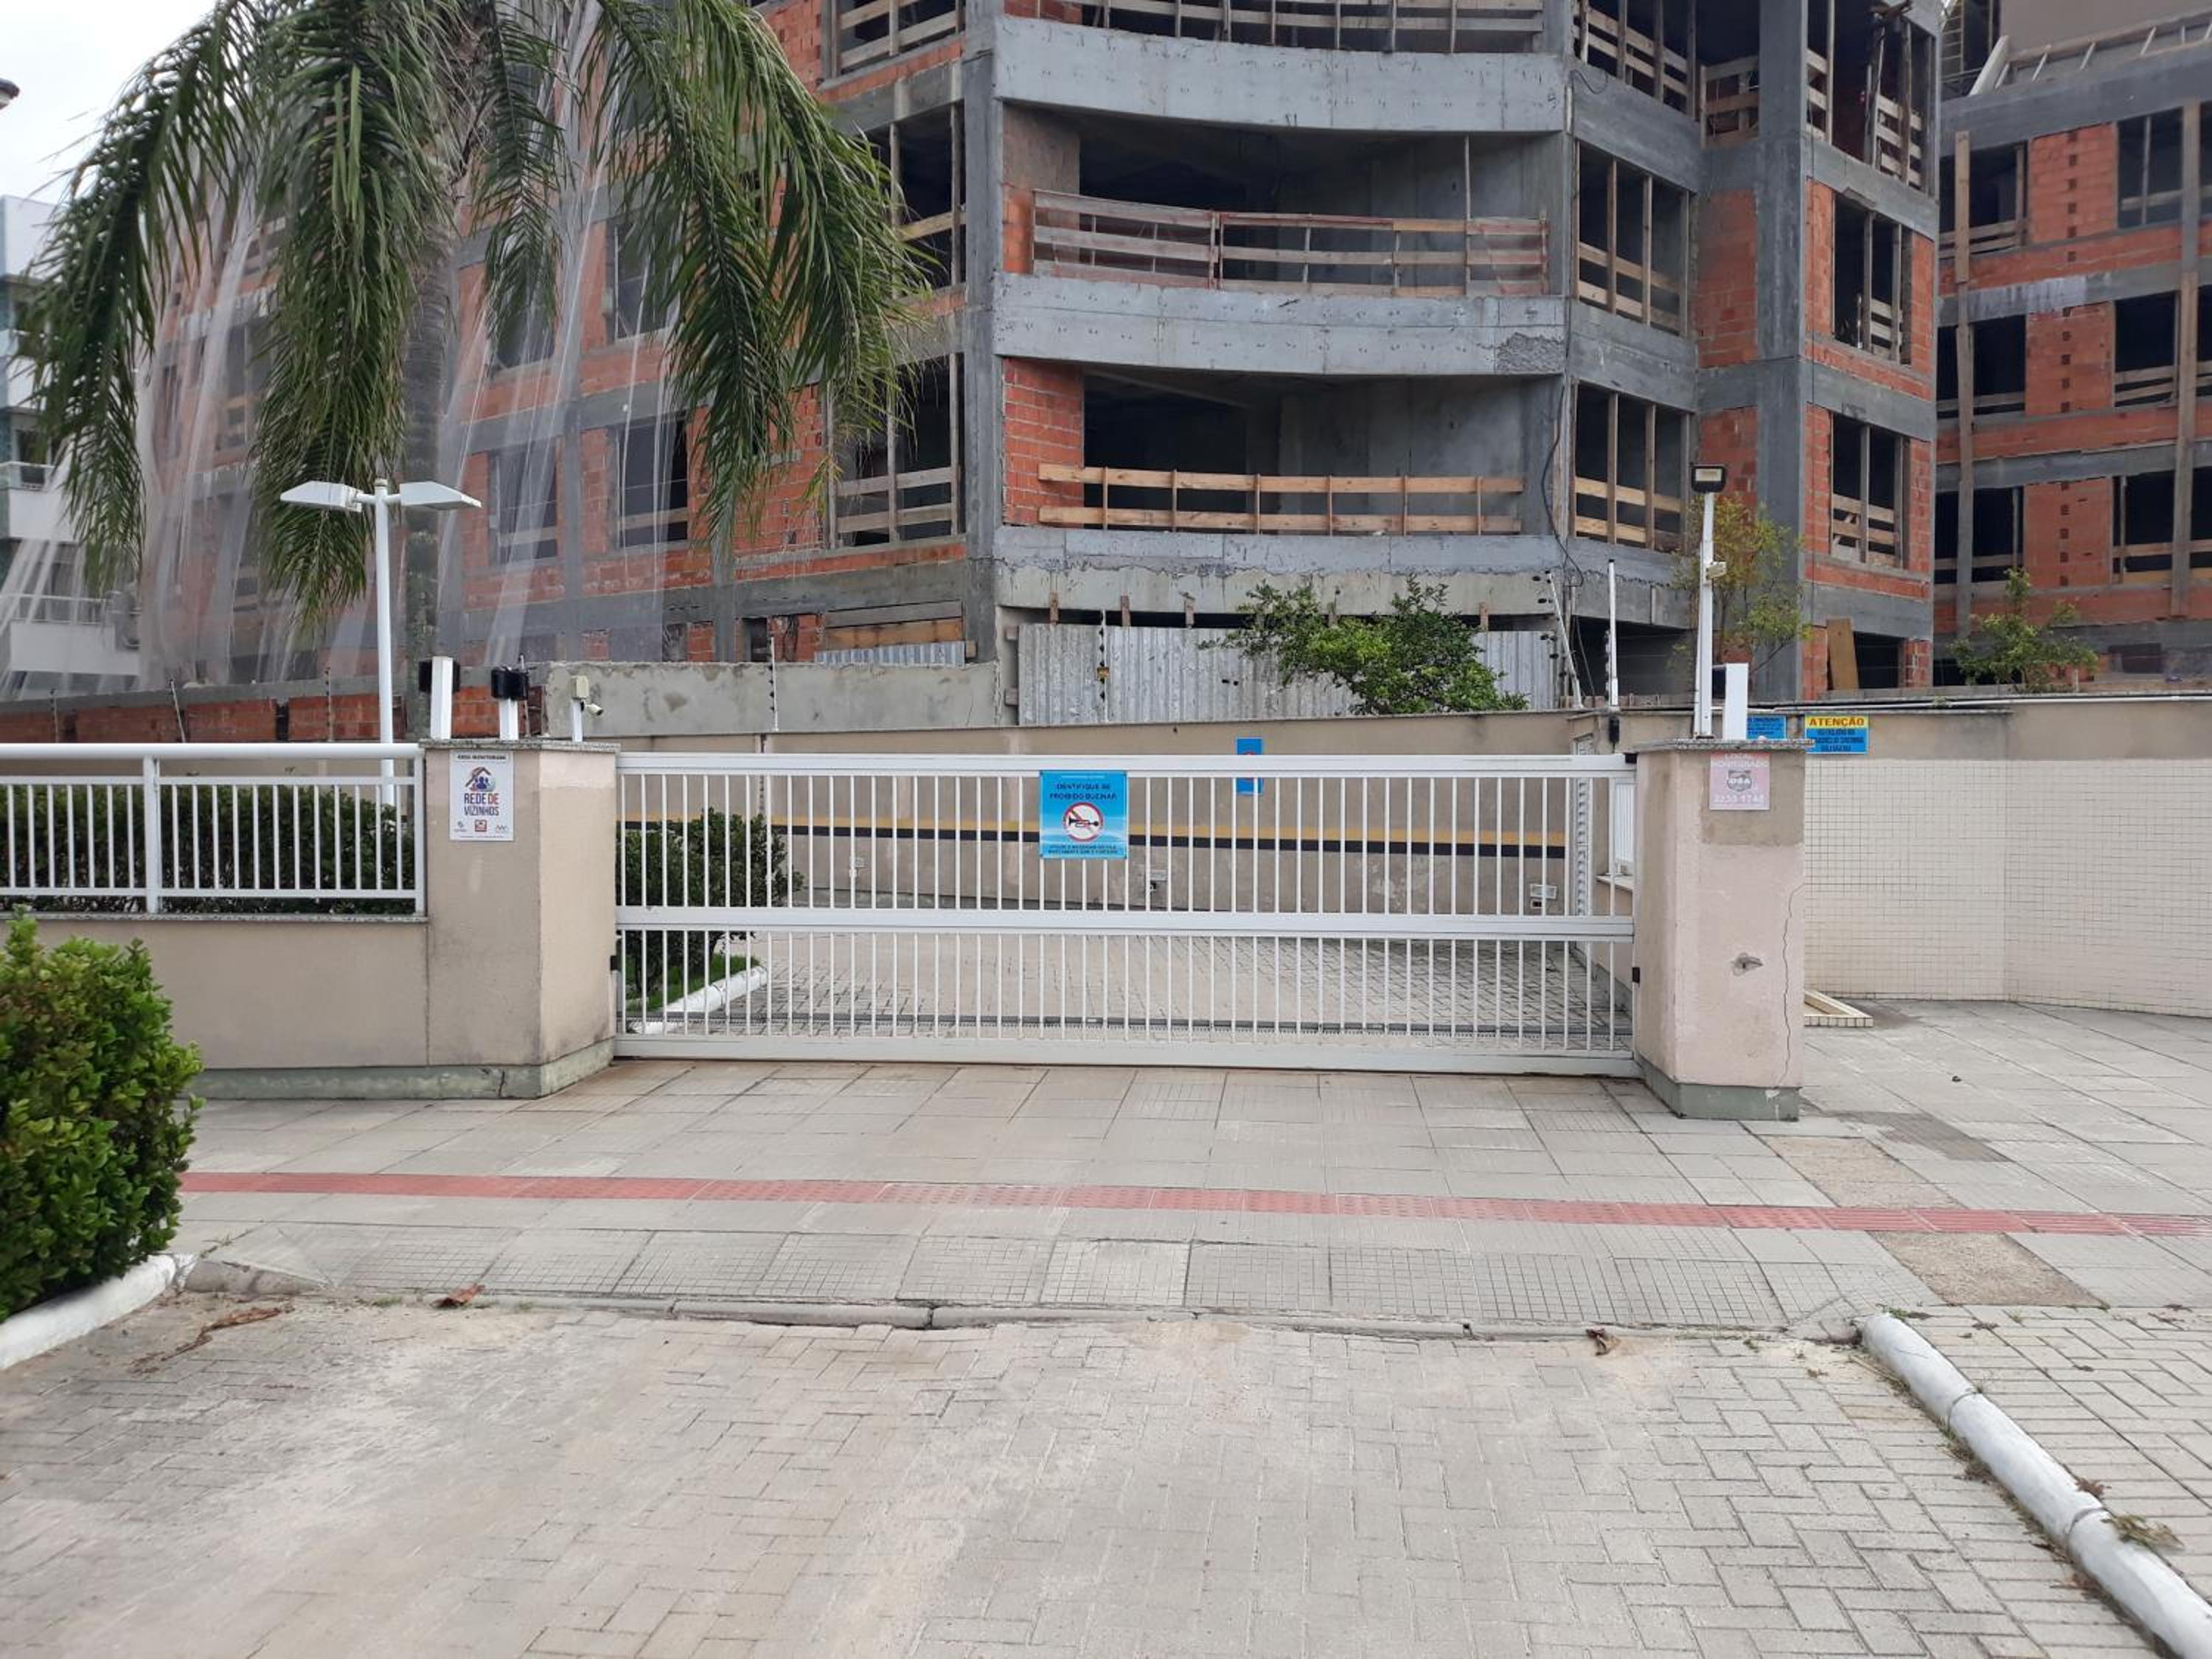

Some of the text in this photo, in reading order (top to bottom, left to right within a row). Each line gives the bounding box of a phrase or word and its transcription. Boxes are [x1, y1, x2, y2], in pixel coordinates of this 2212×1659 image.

[1809, 717, 1865, 727] ATENÇÃO
[464, 793, 500, 805] REDE DE
[464, 806, 499, 816] VIZINHOS
